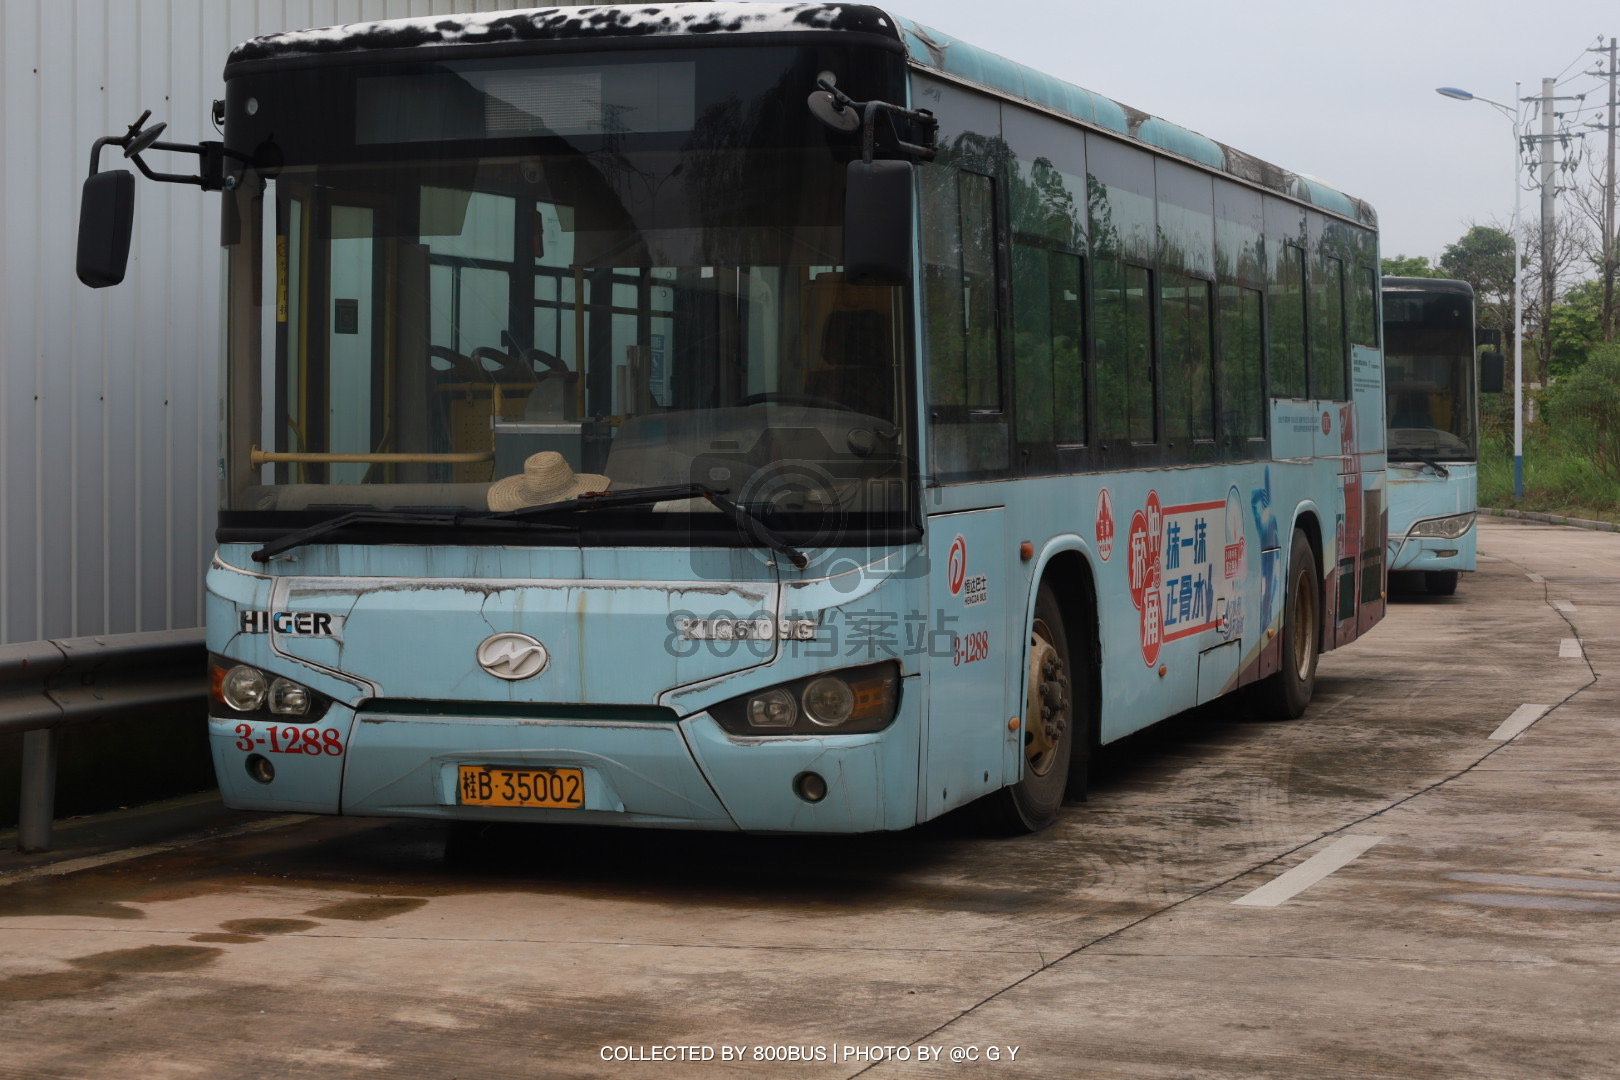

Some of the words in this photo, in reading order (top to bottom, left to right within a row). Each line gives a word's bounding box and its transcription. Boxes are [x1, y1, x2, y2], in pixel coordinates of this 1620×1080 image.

[1148, 506, 1160, 552] 肿
[1166, 517, 1208, 571] 抹一抹
[964, 576, 987, 594] 恒达巴士
[1164, 573, 1205, 627] 正骨水
[240, 611, 332, 634] HIGER
[1144, 584, 1159, 646] 痛
[954, 630, 988, 666] 3-1288
[235, 723, 343, 756] 3-1288
